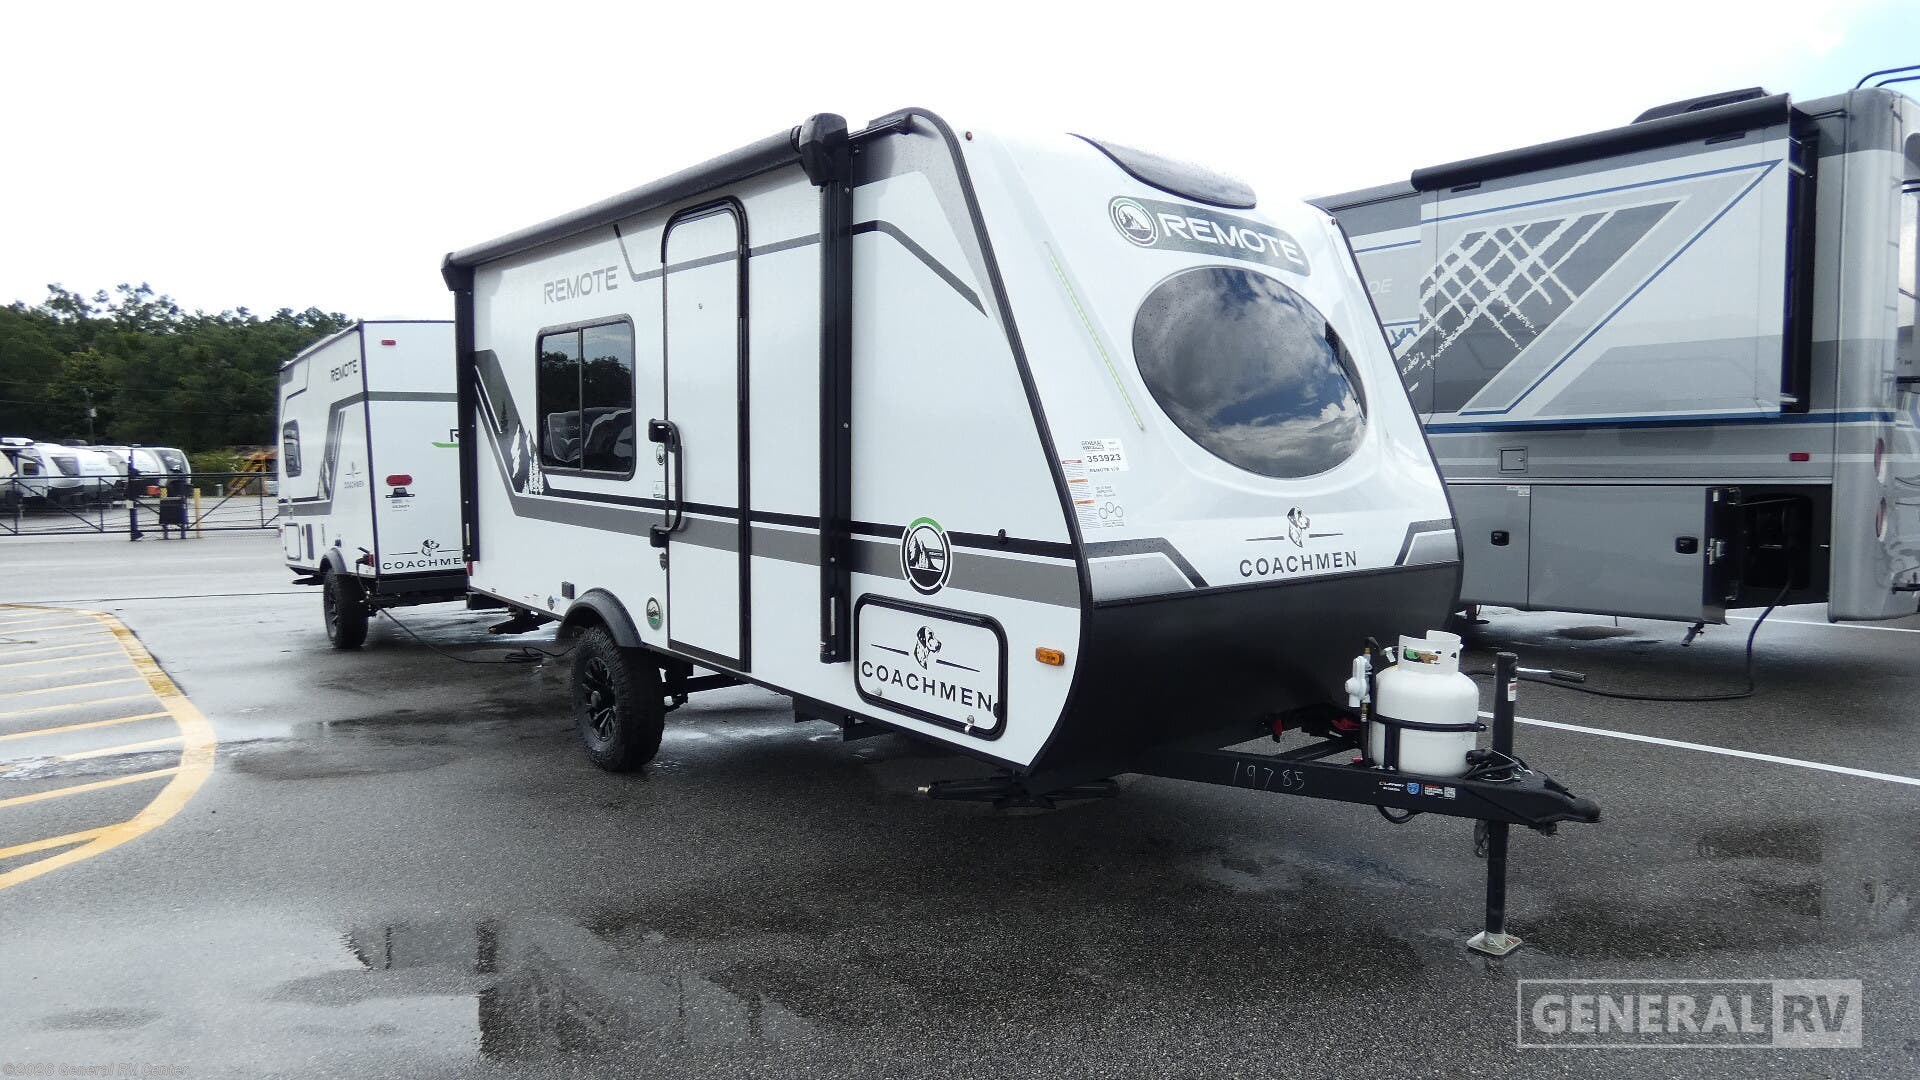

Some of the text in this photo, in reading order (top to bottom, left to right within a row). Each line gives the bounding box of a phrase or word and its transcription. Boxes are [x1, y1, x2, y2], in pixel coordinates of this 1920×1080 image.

[1156, 212, 1305, 266] REMOTE
[543, 265, 618, 304] REMOTE
[330, 359, 358, 383] REMOTE
[1086, 453, 1122, 463] 353923
[382, 557, 462, 571] COACHME
[1239, 550, 1358, 578] COACHMEN
[861, 660, 993, 712] COACHMEN
[1233, 761, 1305, 790] 19785
